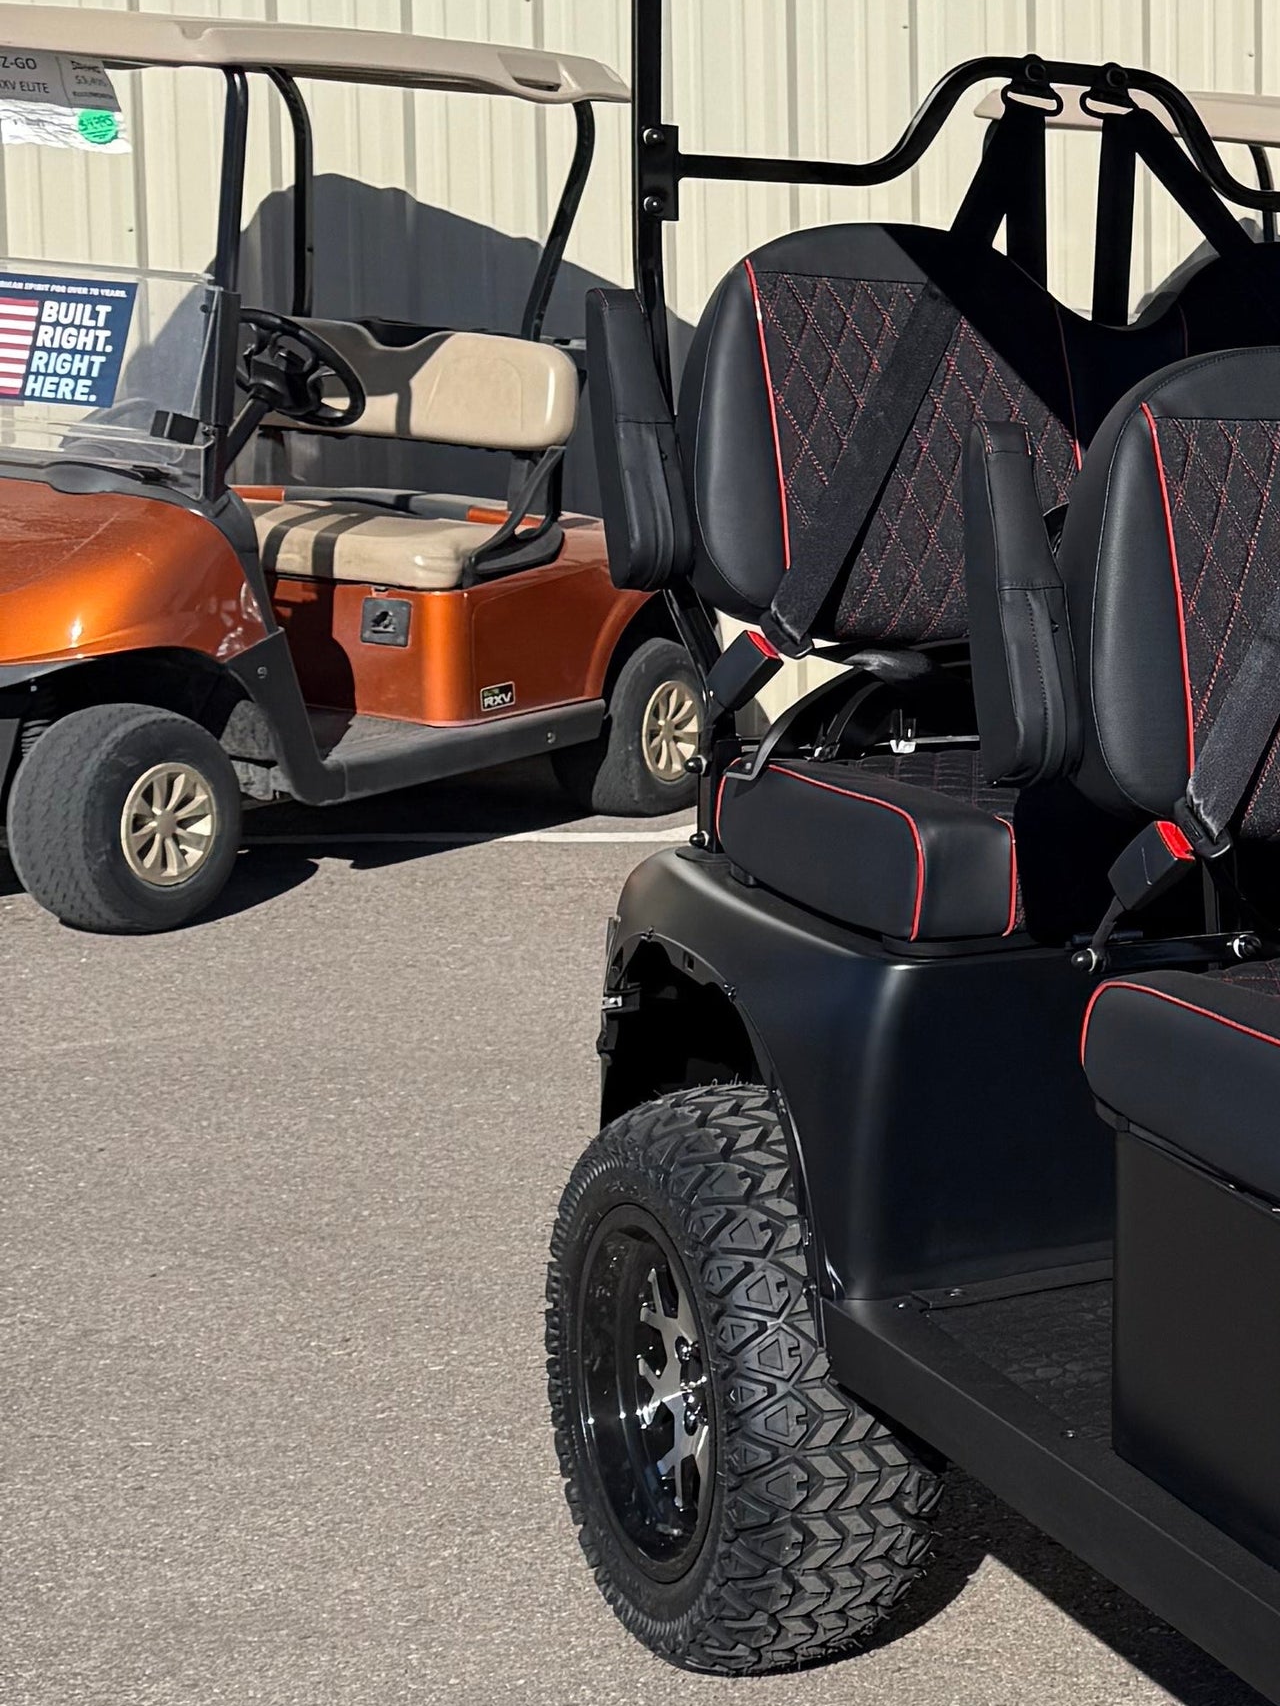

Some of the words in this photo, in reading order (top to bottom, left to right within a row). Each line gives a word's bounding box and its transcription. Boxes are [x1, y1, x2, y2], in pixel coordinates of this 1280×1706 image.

[41, 300, 112, 327] BUILT
[35, 324, 113, 353] RIGHT.
[30, 350, 107, 378] RIGHT
[24, 374, 97, 402] HERE.
[484, 691, 512, 709] RXV
